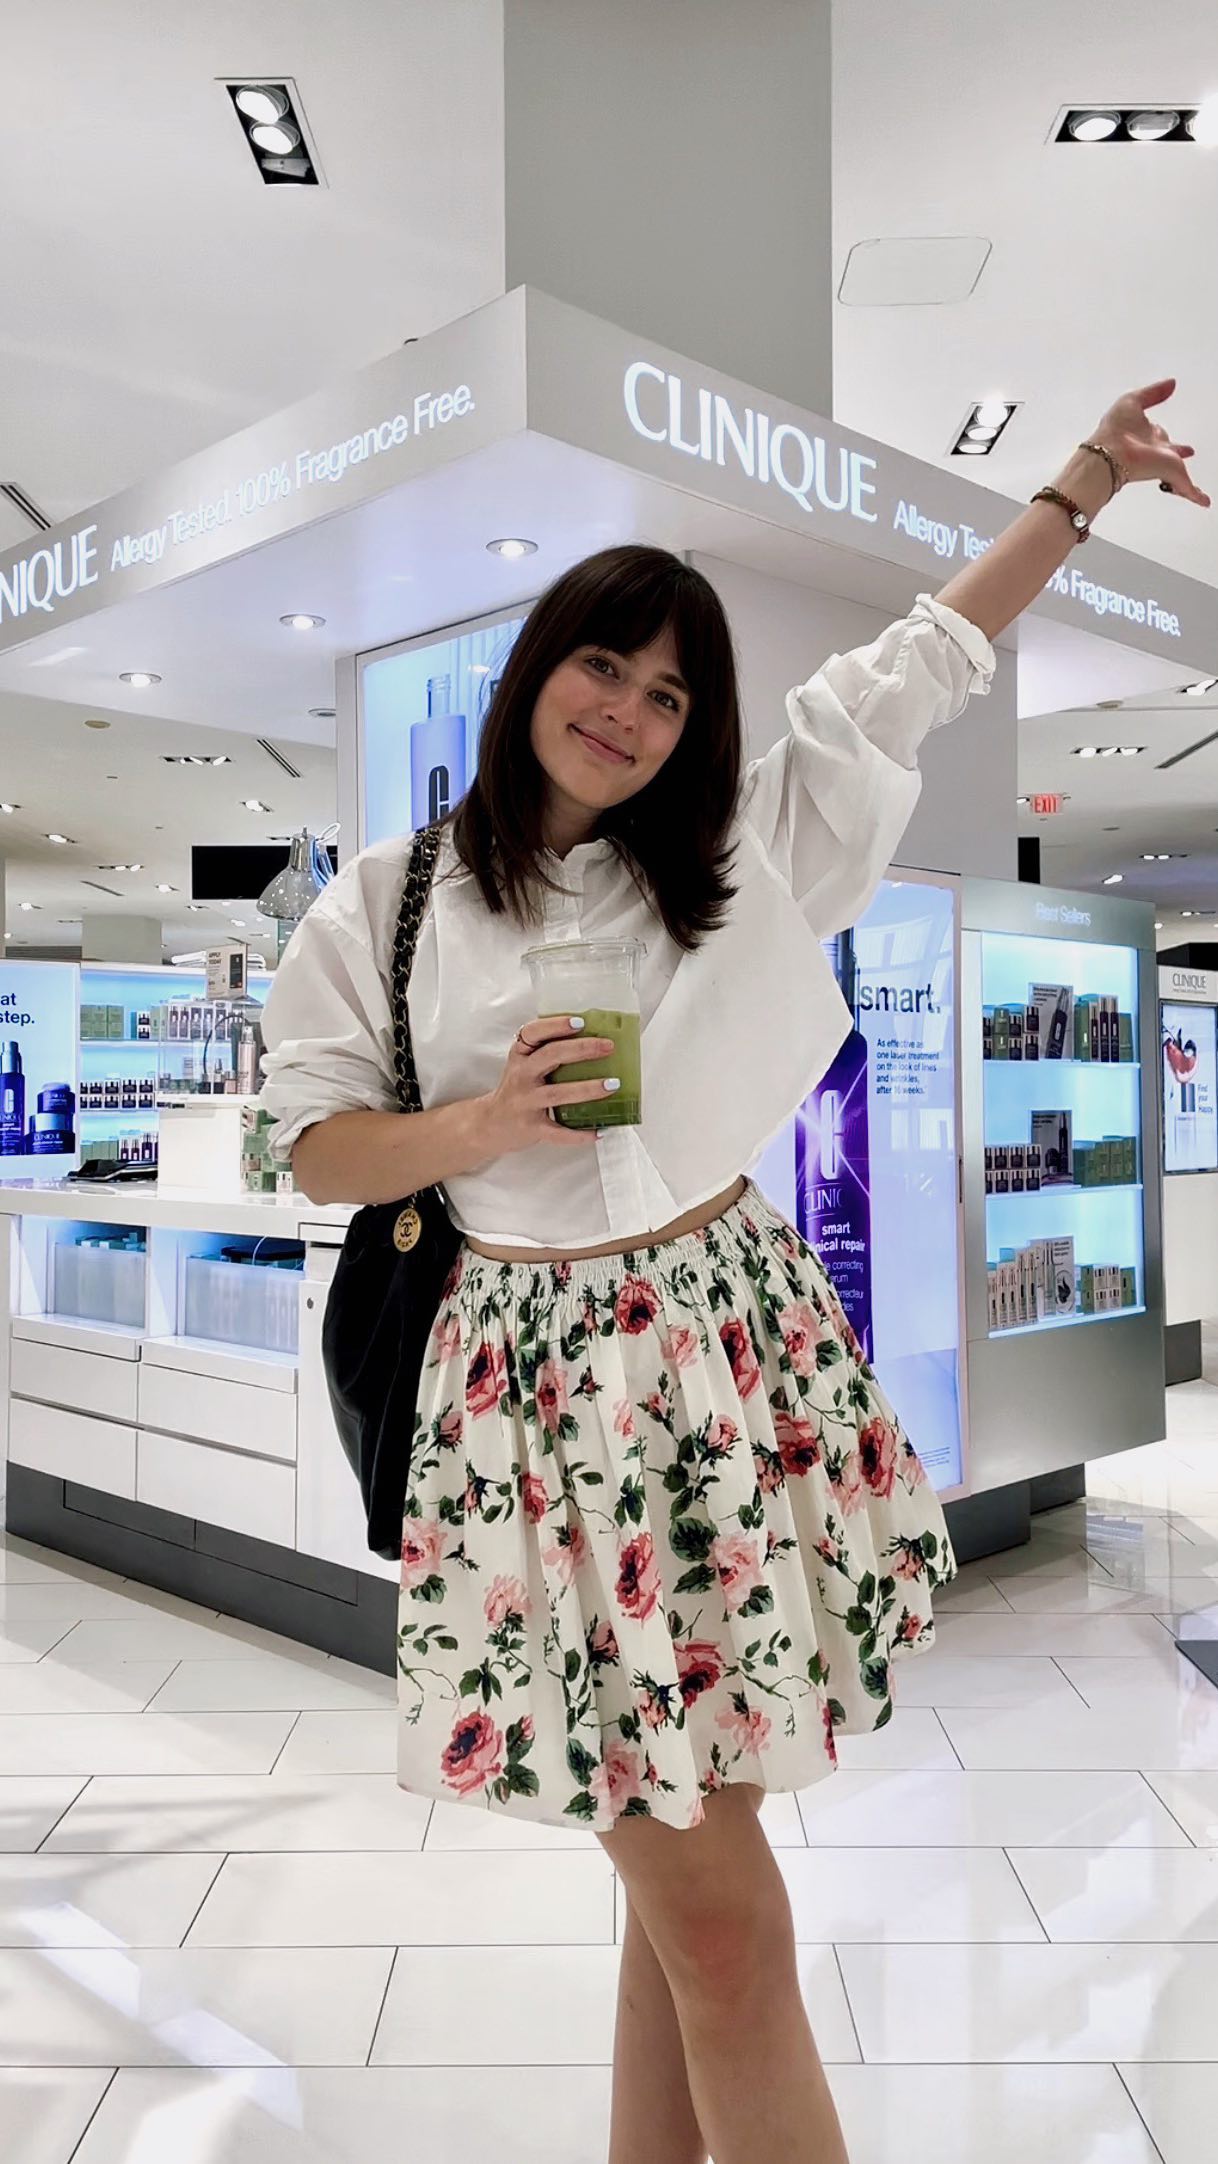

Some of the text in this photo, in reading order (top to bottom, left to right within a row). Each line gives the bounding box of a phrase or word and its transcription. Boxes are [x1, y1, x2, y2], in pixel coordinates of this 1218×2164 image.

[624, 361, 877, 522] CLINIQUE
[110, 525, 167, 572] Allergy
[167, 489, 232, 545] Tested.
[236, 461, 290, 516] 100%
[295, 414, 408, 489] Fragrance
[413, 384, 475, 434] Free.
[893, 499, 958, 558] Allergy
[1070, 569, 1146, 615] Fragrance
[1147, 599, 1181, 637] Free.
[1034, 796, 1057, 813] EXIT
[1060, 905, 1091, 927] Sellers
[1172, 973, 1206, 990] CLINIQUE
[860, 983, 941, 1014] smart.
[877, 1038, 886, 1048] As
[876, 1051, 889, 1059] one
[908, 1051, 939, 1060] treatment
[913, 1062, 921, 1071] of
[876, 1074, 889, 1082] and
[876, 1085, 892, 1094] after
[821, 1221, 851, 1236] smart
[840, 1238, 866, 1253] repair
[831, 1260, 864, 1273] correcting
